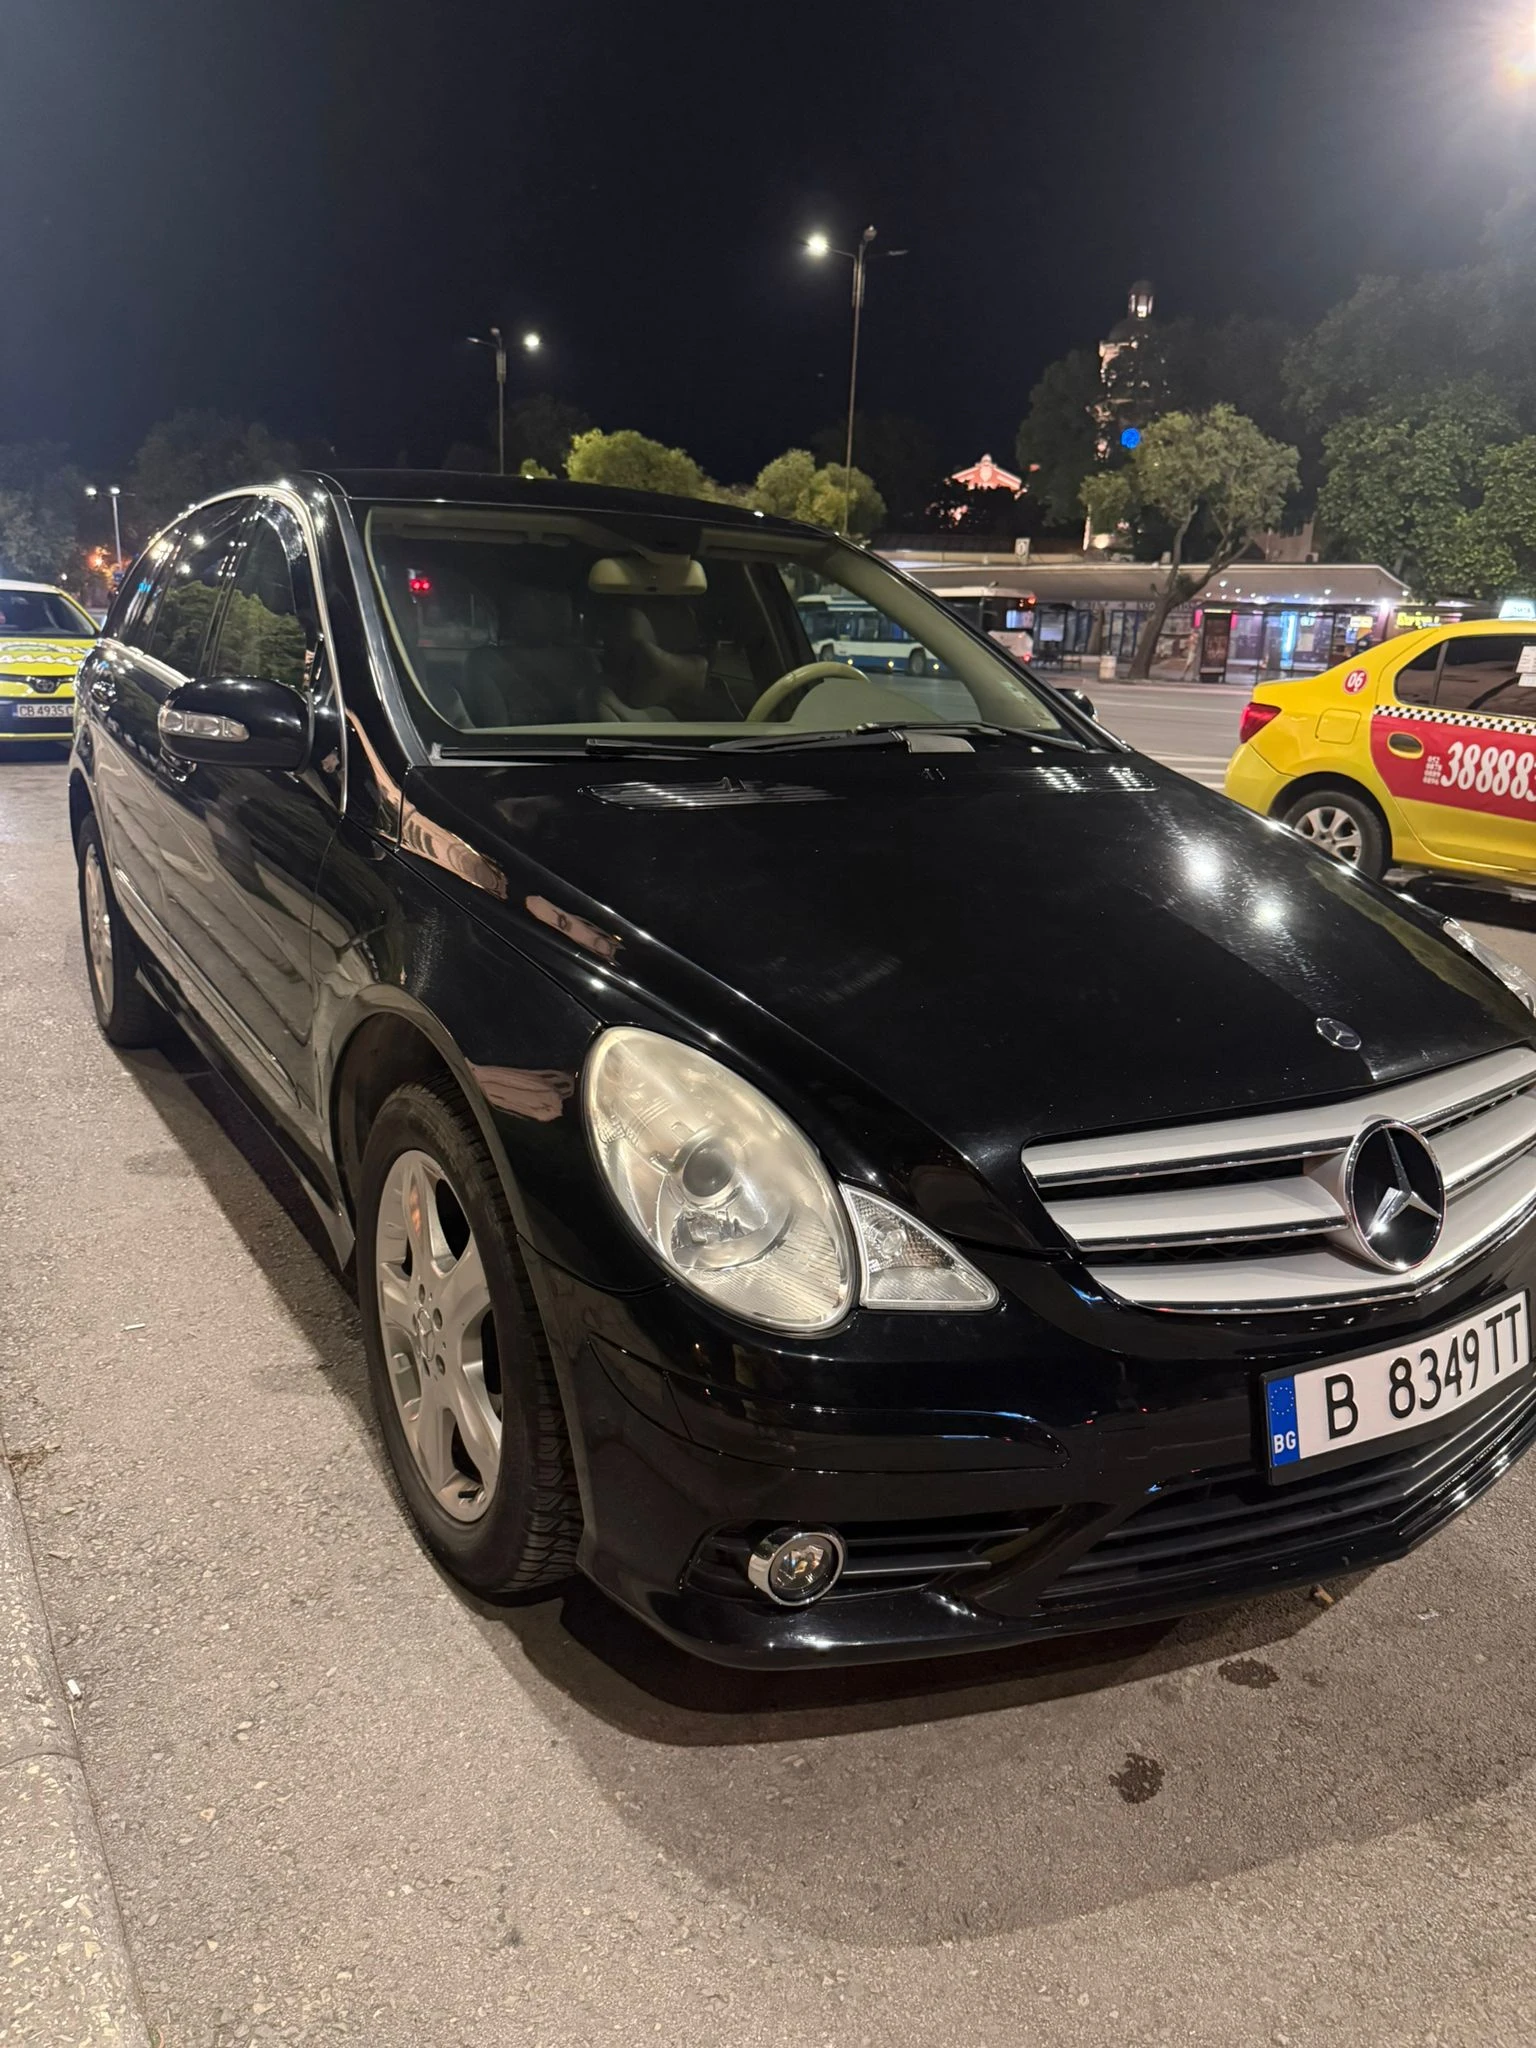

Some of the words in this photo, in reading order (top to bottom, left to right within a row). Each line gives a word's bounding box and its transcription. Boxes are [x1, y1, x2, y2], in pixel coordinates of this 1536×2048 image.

[1347, 672, 1365, 691] 06
[20, 705, 34, 717] CB
[1440, 741, 1536, 802] 38888
[1325, 1373, 1359, 1440] B
[1388, 1328, 1479, 1419] 8349
[1484, 1303, 1521, 1375] TT
[1273, 1430, 1296, 1454] BG
